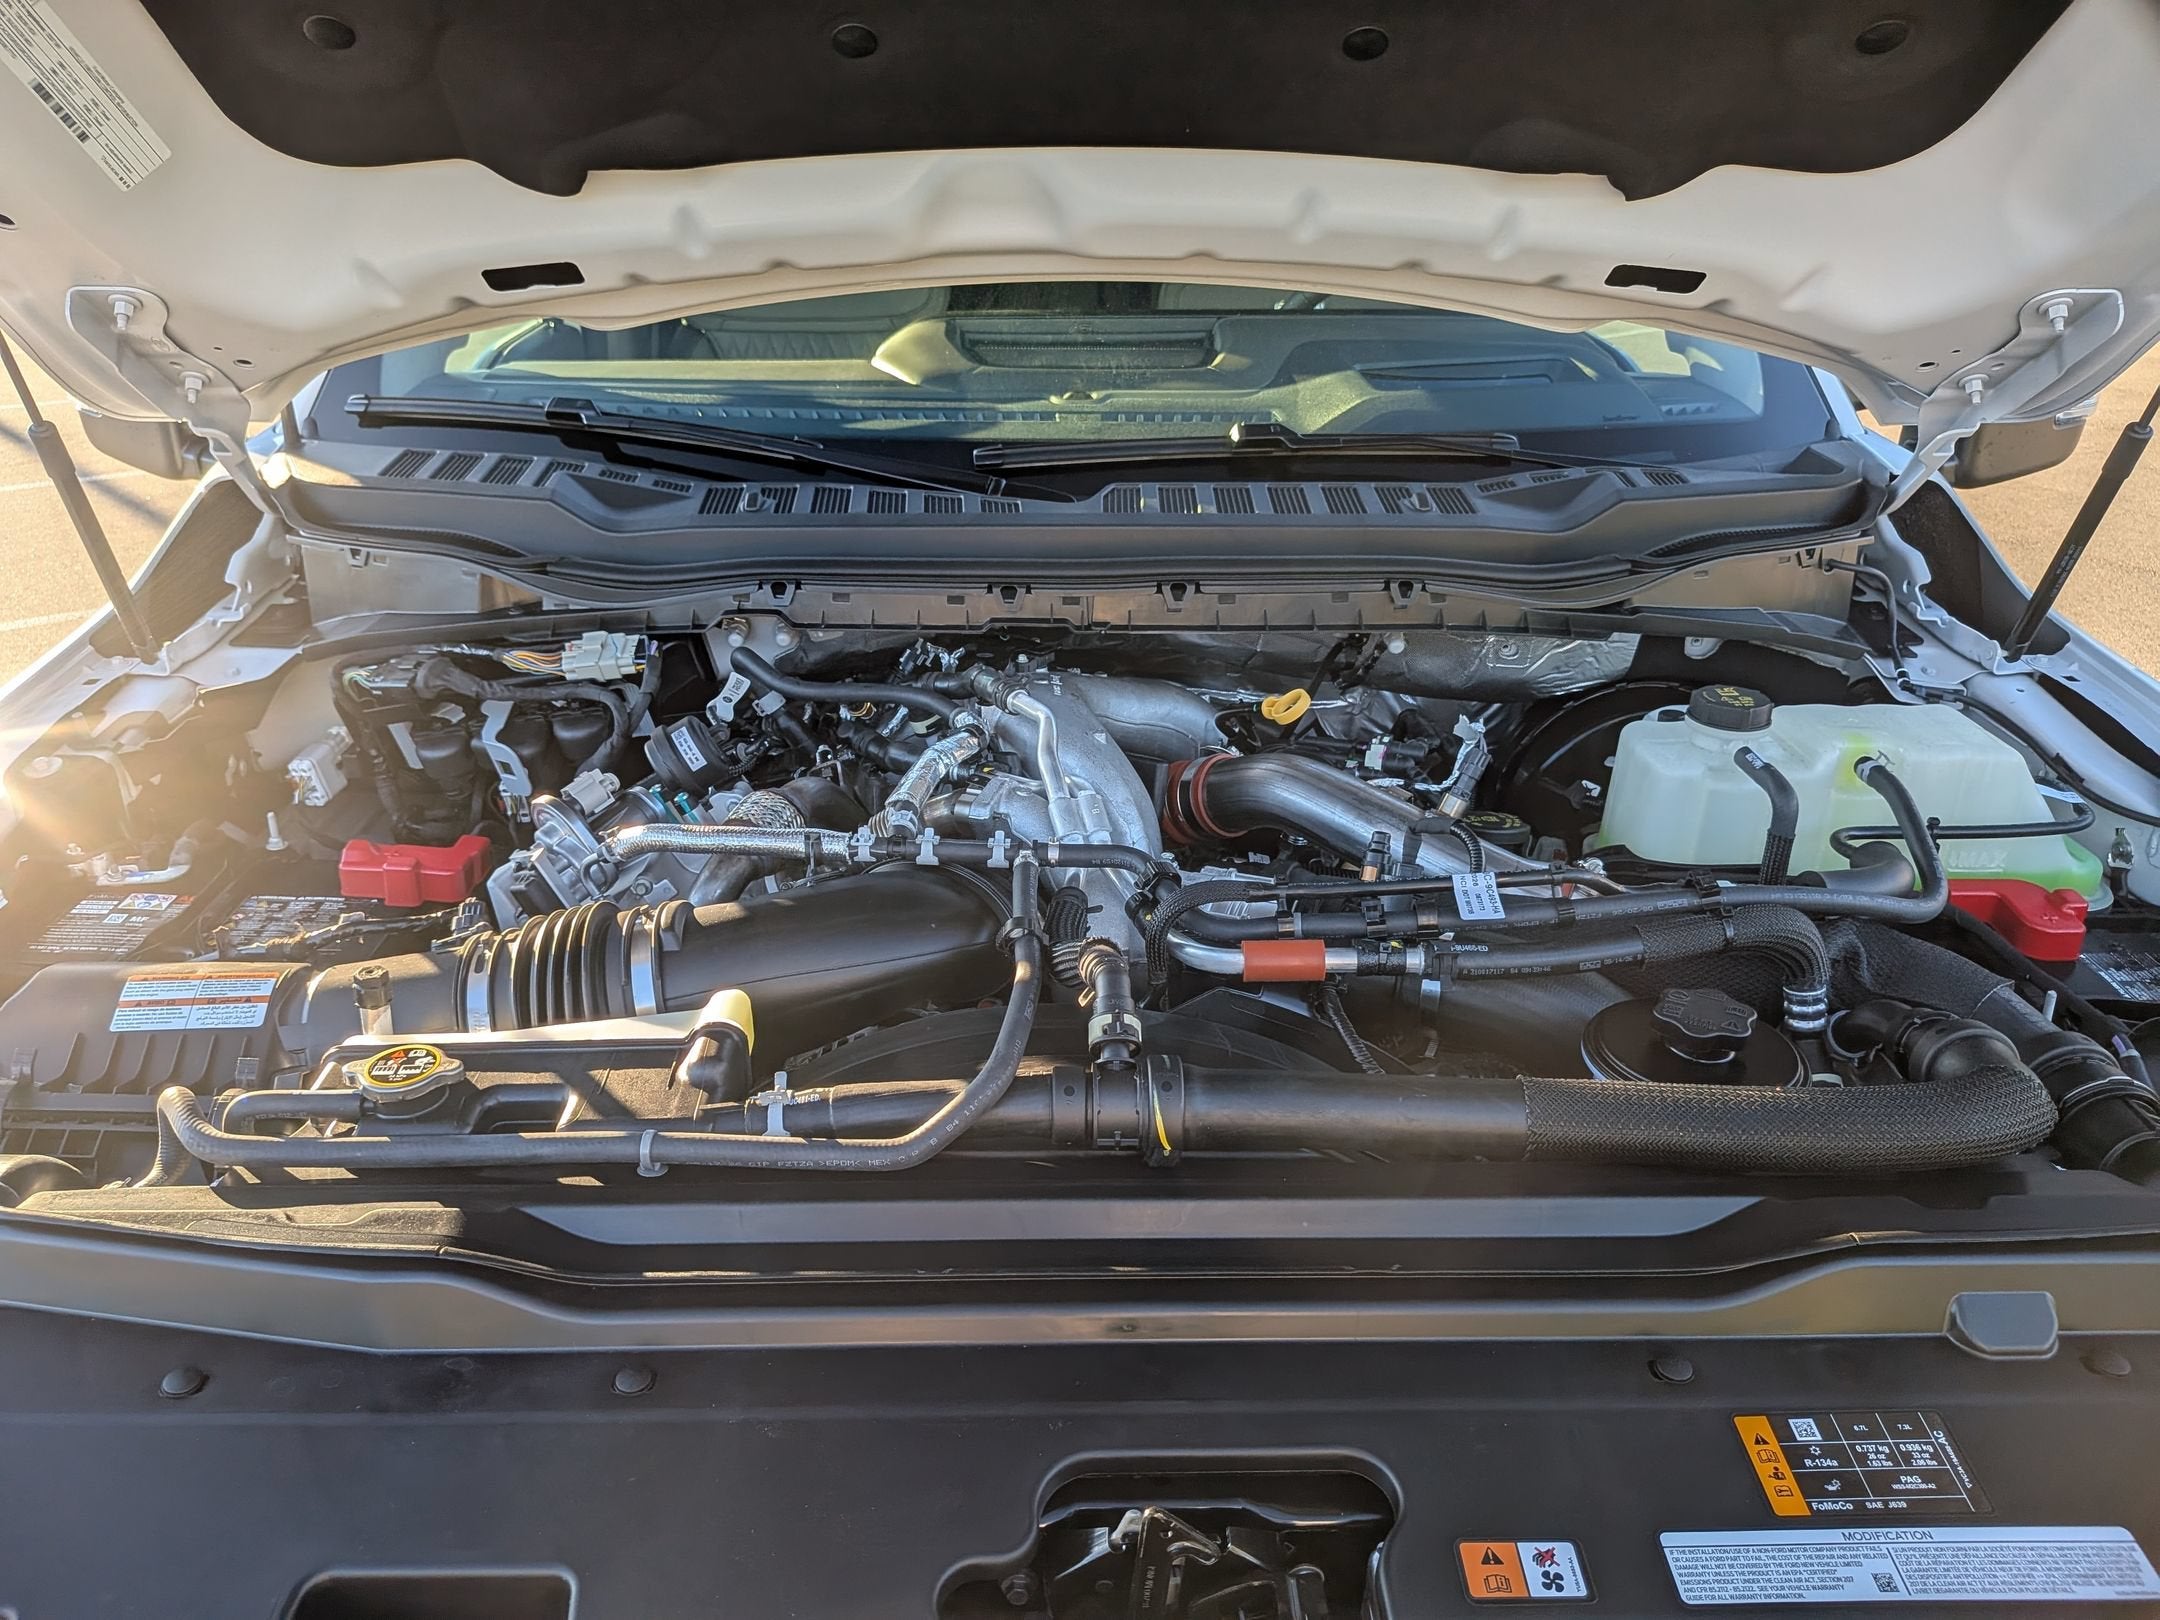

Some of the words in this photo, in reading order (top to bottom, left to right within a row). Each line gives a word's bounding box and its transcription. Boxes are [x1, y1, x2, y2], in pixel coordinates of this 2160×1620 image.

[1855, 1445, 1876, 1453] 0.737
[1877, 1445, 1889, 1454] kg
[1900, 1444, 1922, 1452] 0.936
[1923, 1444, 1934, 1453] kg
[1804, 1458, 1839, 1467] R-134a
[1883, 1459, 1893, 1467] lbs
[1900, 1475, 1922, 1484] PAG
[1811, 1502, 1854, 1511] FoMoCo
[1865, 1501, 1885, 1510] SAE
[1887, 1501, 1907, 1509] J639
[1841, 1530, 1934, 1542] MODIFICATION
